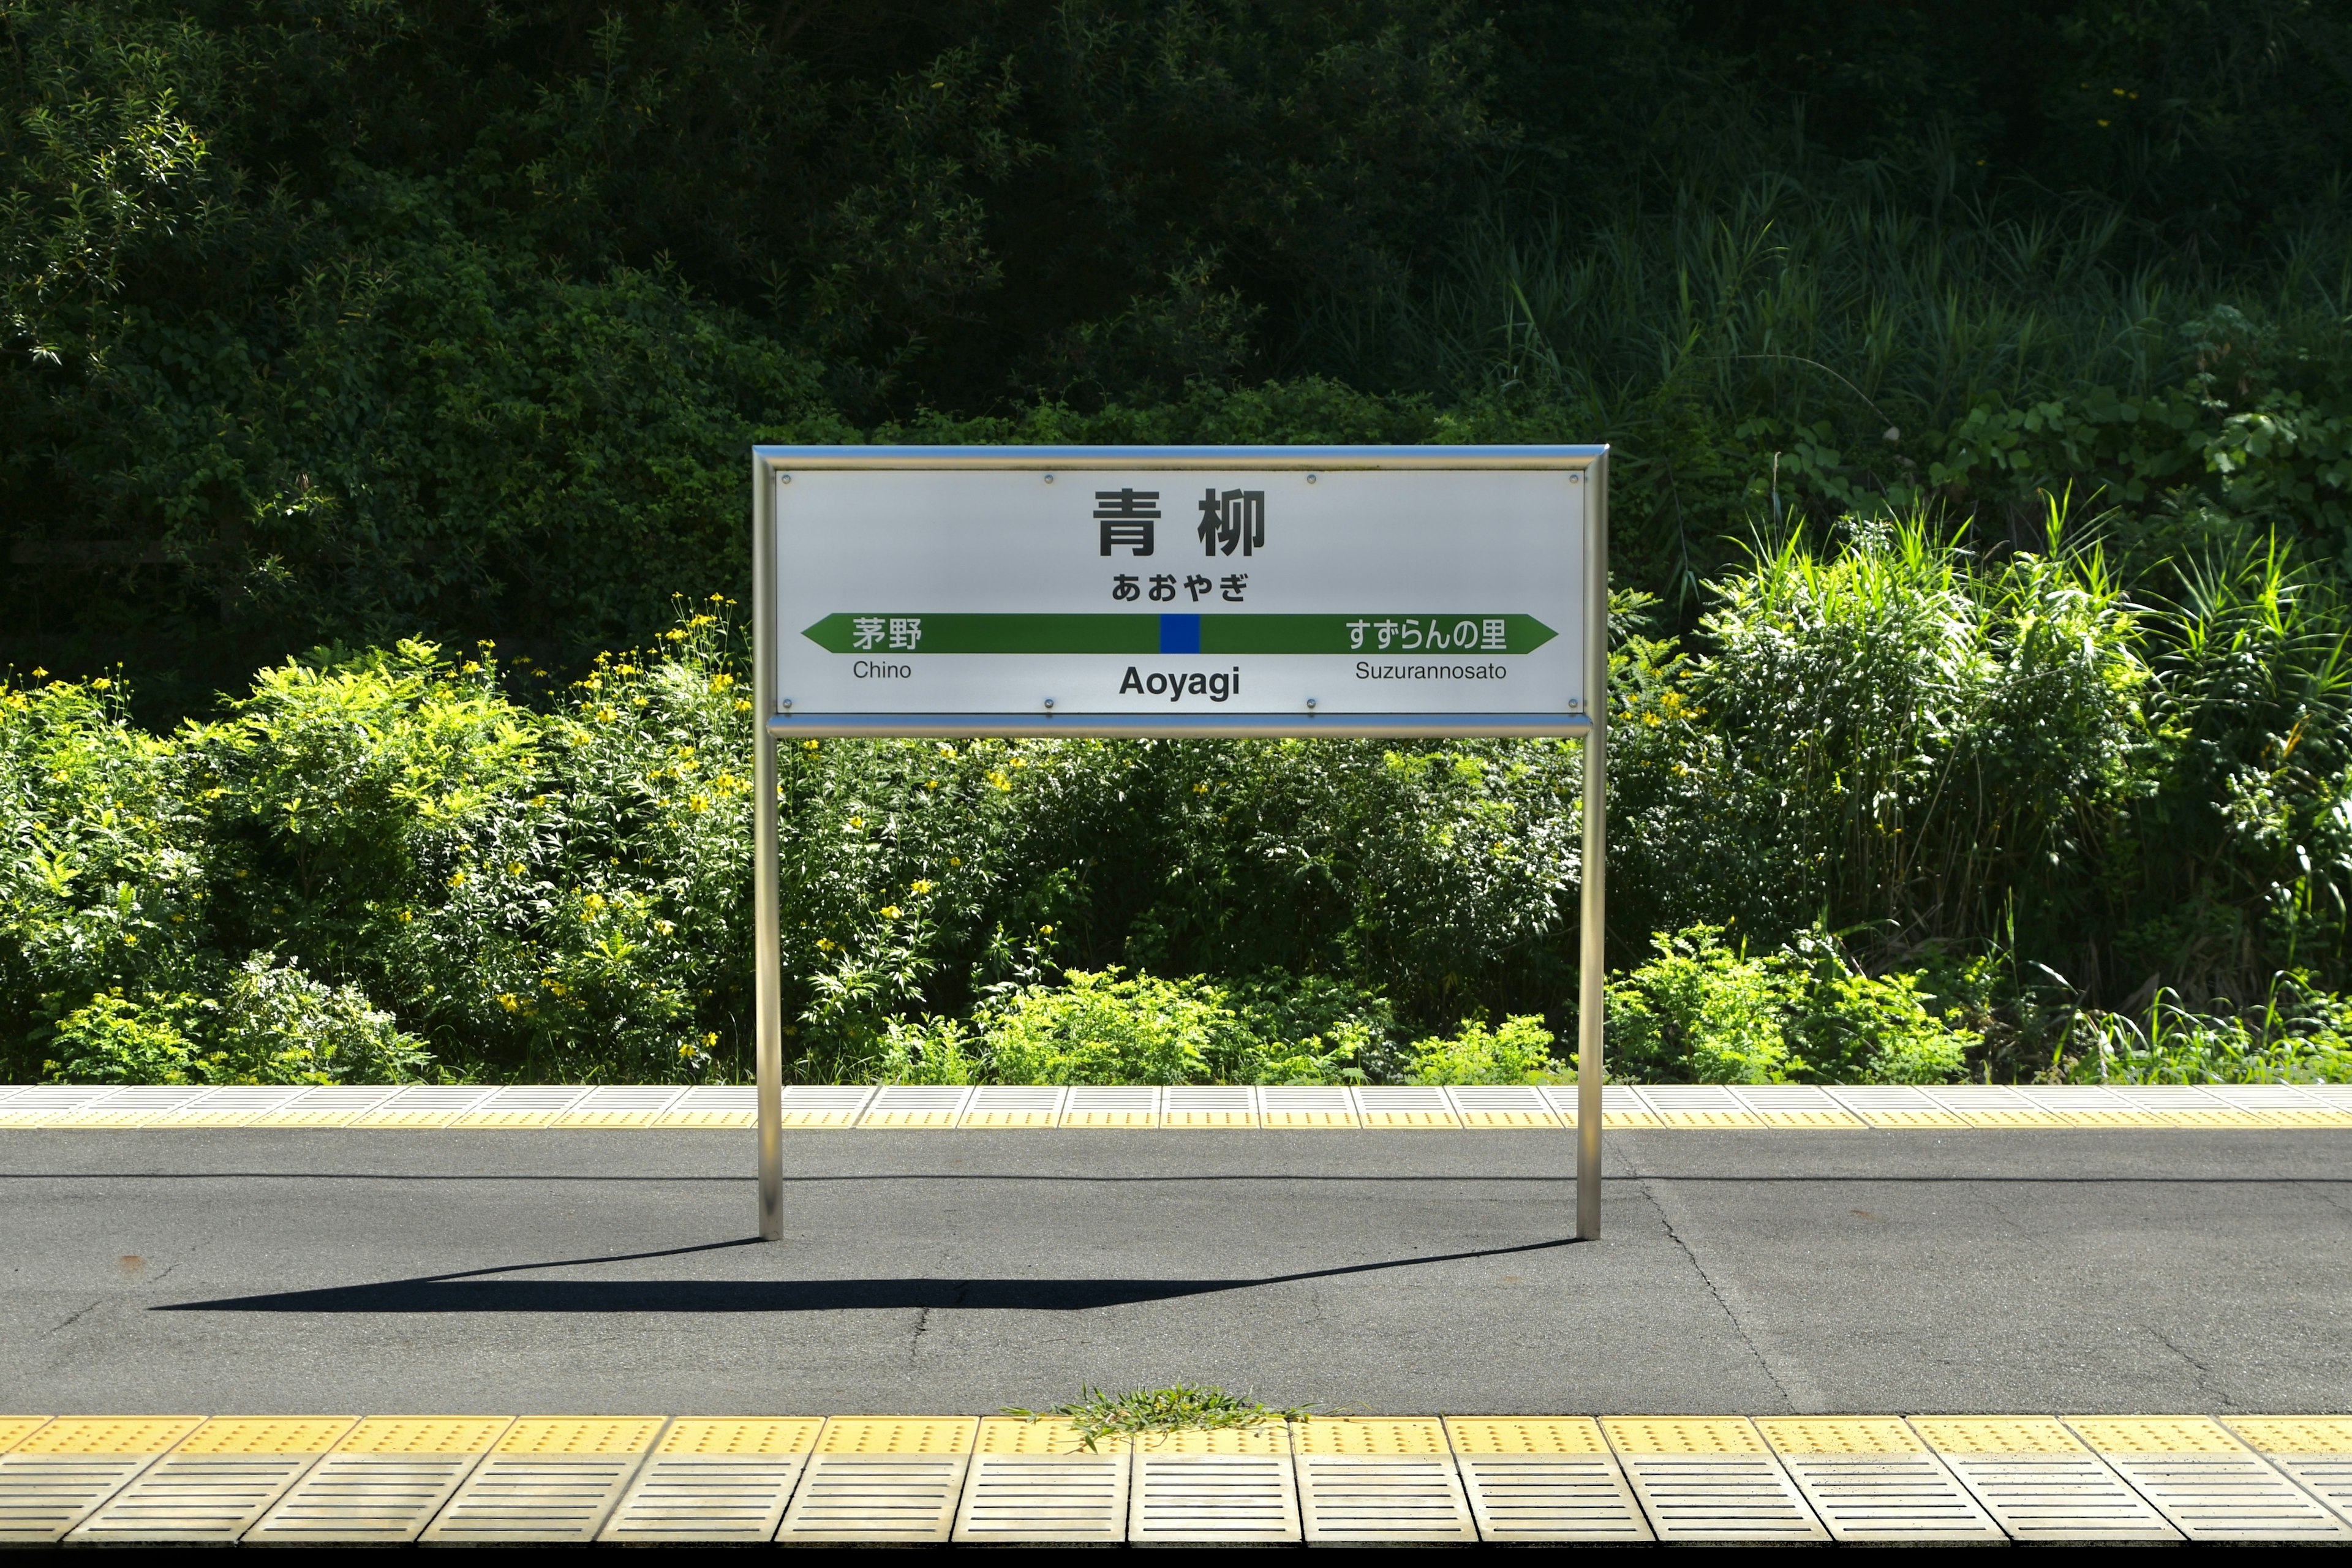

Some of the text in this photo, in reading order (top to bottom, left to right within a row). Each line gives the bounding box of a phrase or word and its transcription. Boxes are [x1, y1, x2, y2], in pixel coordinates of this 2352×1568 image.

[1093, 488, 1265, 557] 青柳
[1112, 573, 1250, 602] あおやぎ
[853, 617, 922, 650] 茅野
[1346, 619, 1507, 649] すずらんの里
[853, 660, 912, 679] Chino
[1119, 666, 1240, 703] Aoyagi
[1355, 660, 1507, 680] Suzurannosato
